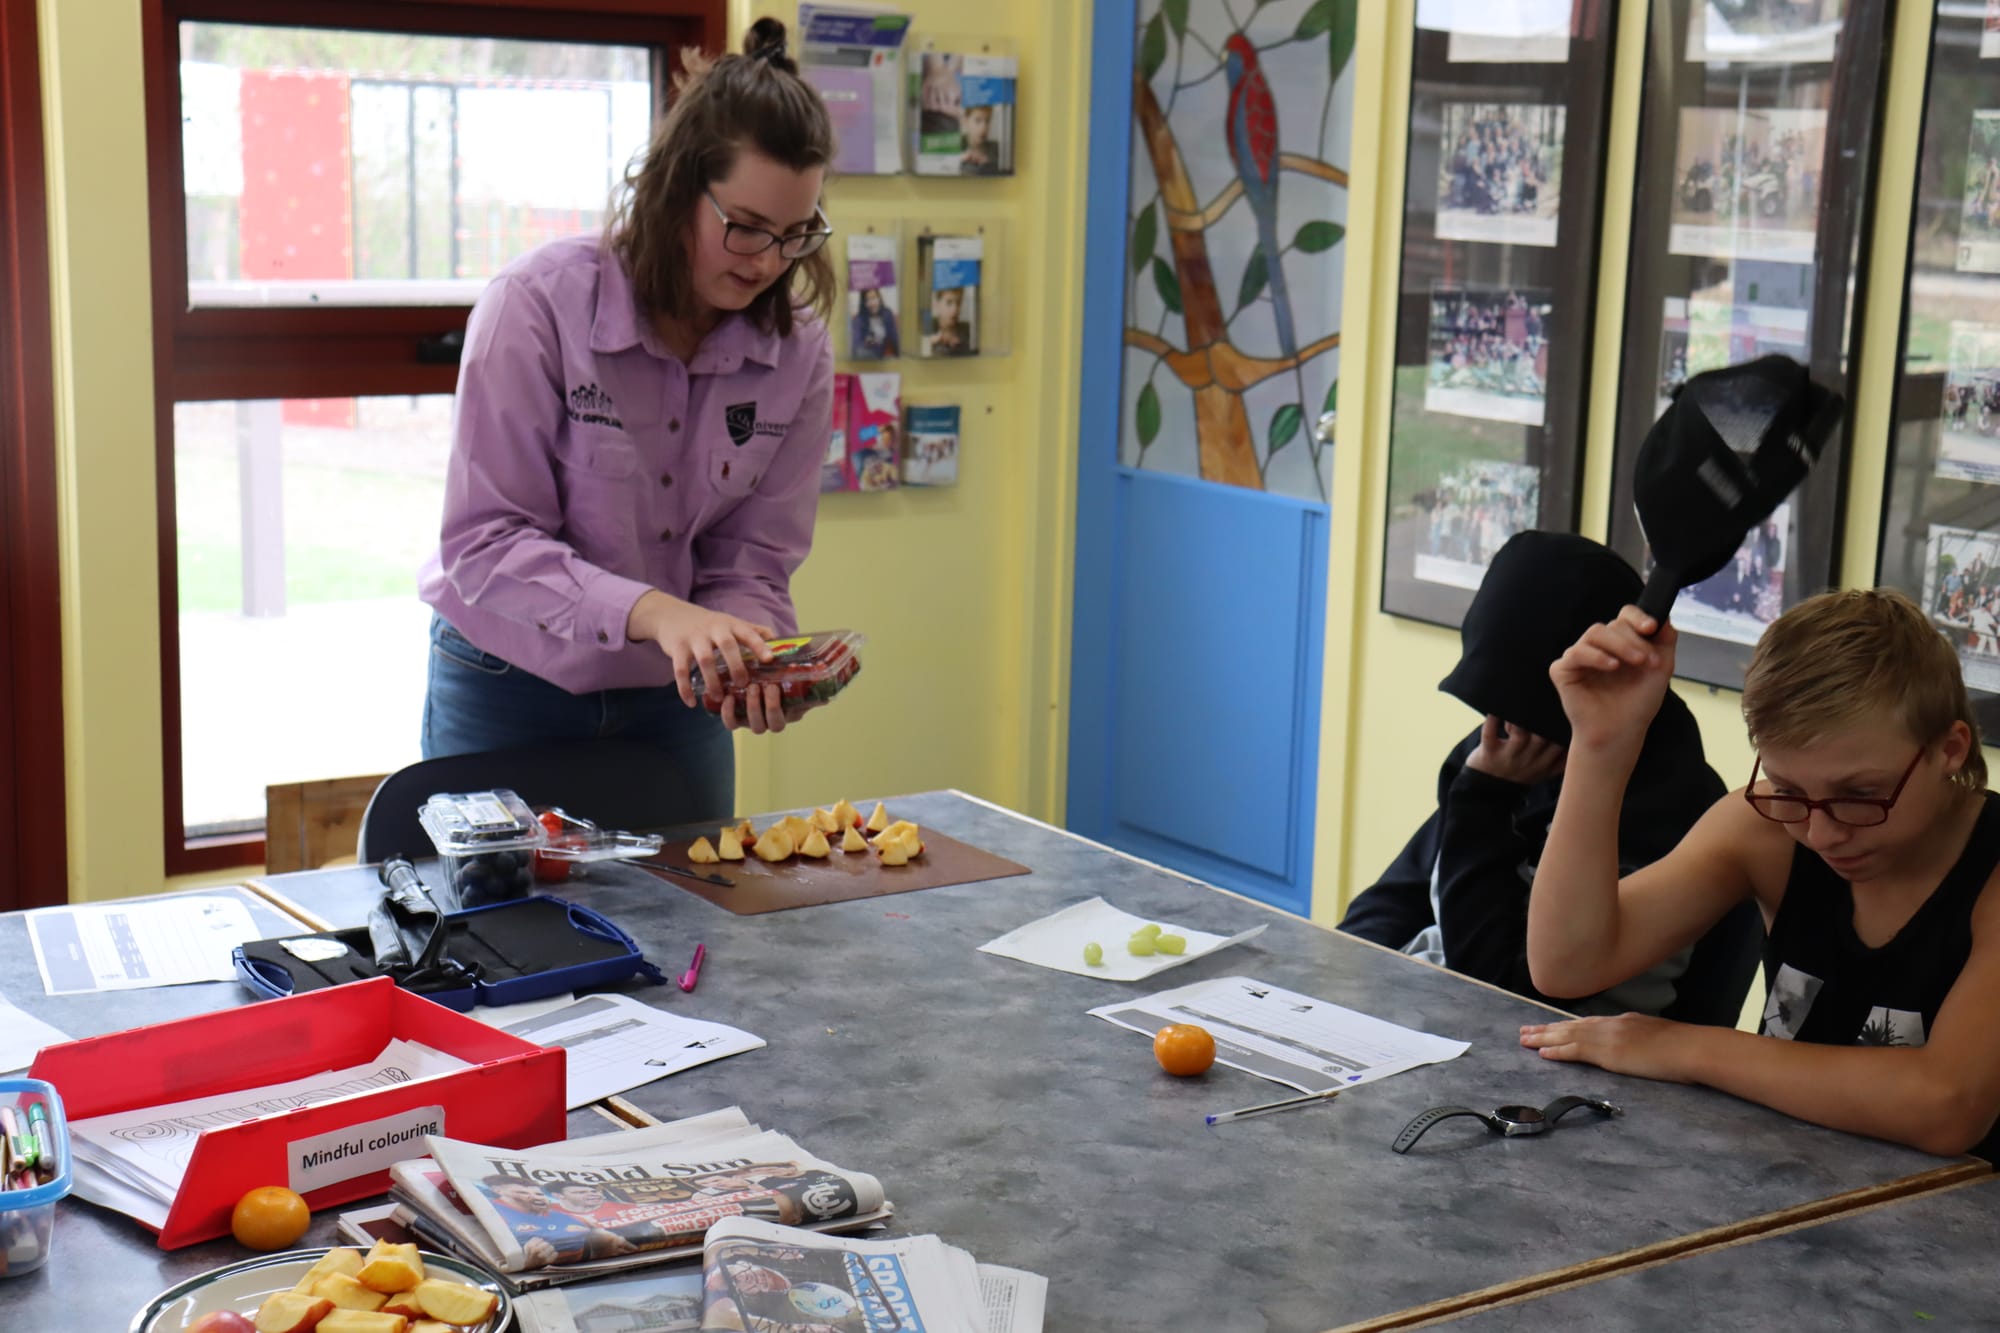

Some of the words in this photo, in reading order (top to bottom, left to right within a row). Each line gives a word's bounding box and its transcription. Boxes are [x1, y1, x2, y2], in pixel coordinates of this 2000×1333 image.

[302, 1139, 364, 1169] Mindful
[368, 1121, 438, 1151] colouring
[486, 1159, 652, 1184] Herald
[662, 1157, 753, 1178] Sun
[656, 1210, 709, 1225] WHO'S
[855, 1257, 918, 1332] SPORT
